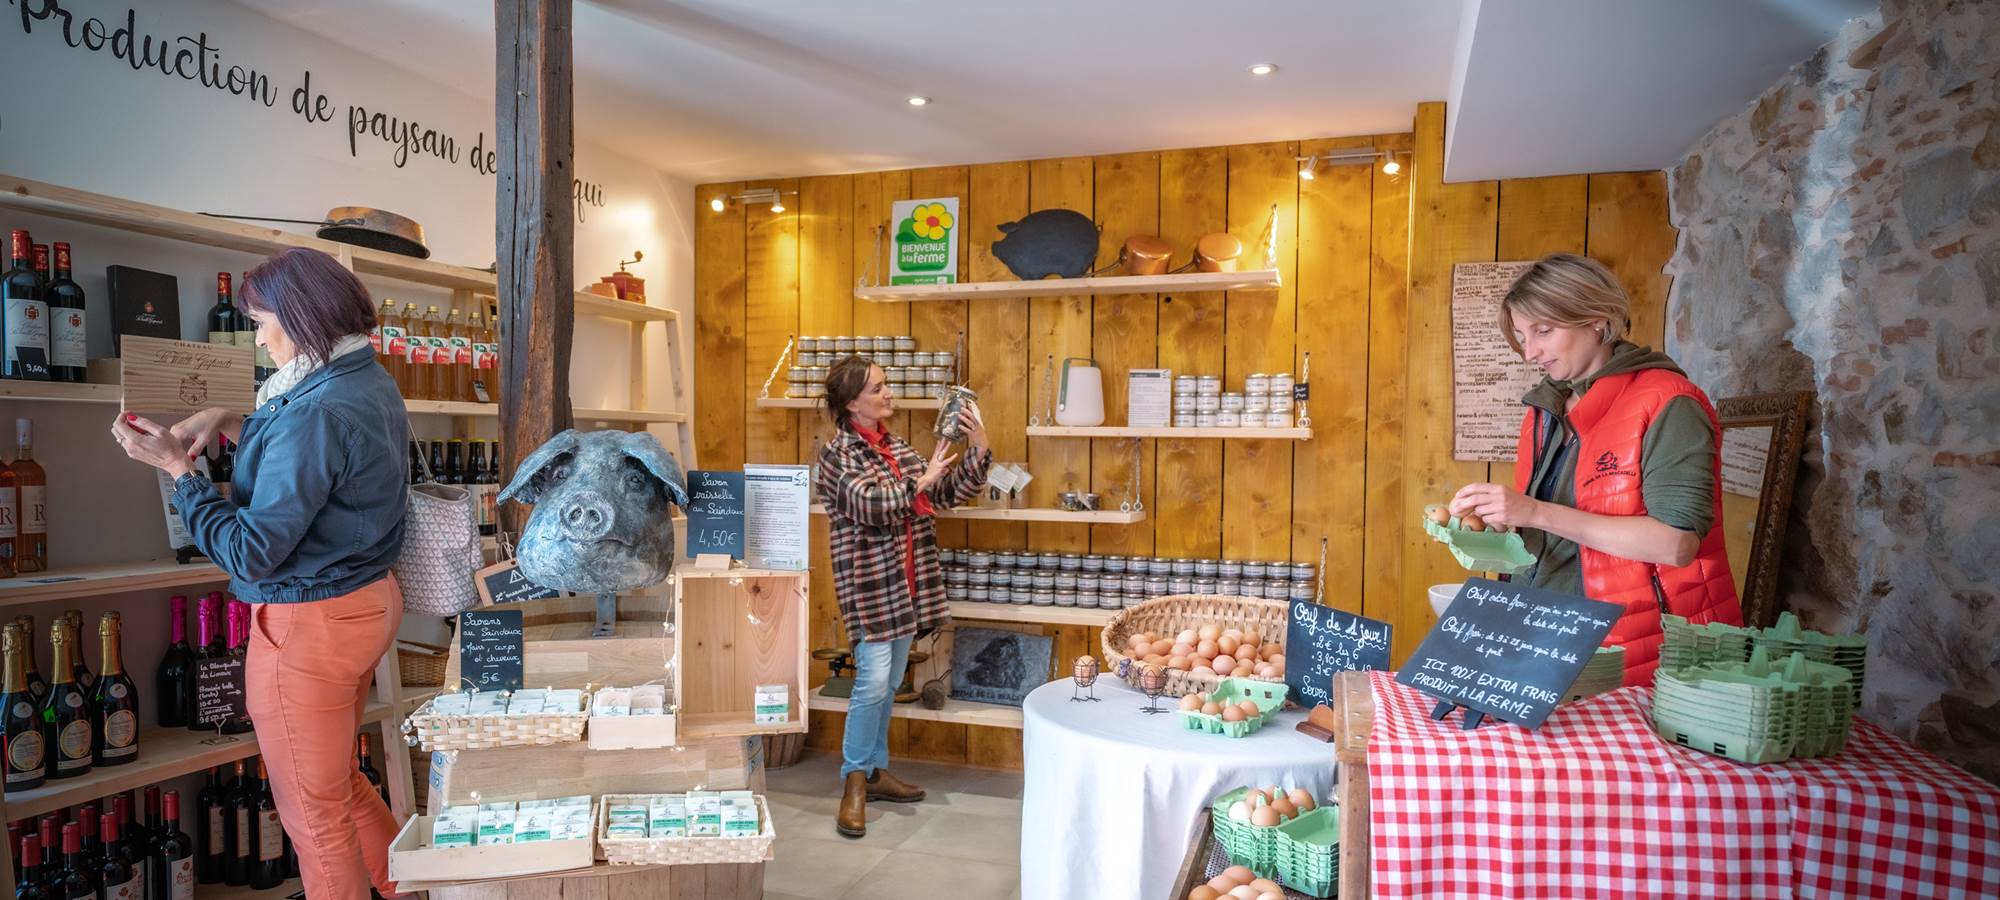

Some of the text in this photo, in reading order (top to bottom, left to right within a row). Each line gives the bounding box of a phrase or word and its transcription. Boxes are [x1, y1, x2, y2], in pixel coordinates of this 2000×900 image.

[9, 0, 277, 107] production
[292, 70, 335, 123] de
[348, 105, 460, 169] paysan
[902, 242, 947, 253] BIENVENUE
[913, 252, 946, 263] ferme
[702, 472, 728, 487] Savon
[693, 488, 736, 500] vaisselle
[707, 503, 744, 515] Saindoux
[699, 528, 737, 547] 4,50€
[464, 612, 501, 626] Savons
[1327, 612, 1341, 631] de
[481, 627, 522, 637] Saindoux
[1336, 642, 1349, 656] les
[1353, 648, 1361, 660] 6
[474, 654, 520, 663] et cheveux
[481, 672, 500, 685] 5€
[1421, 657, 1559, 704] ICI 100% EXTRA FRAIS
[1411, 672, 1534, 719] PRODUIT A LA FERME
